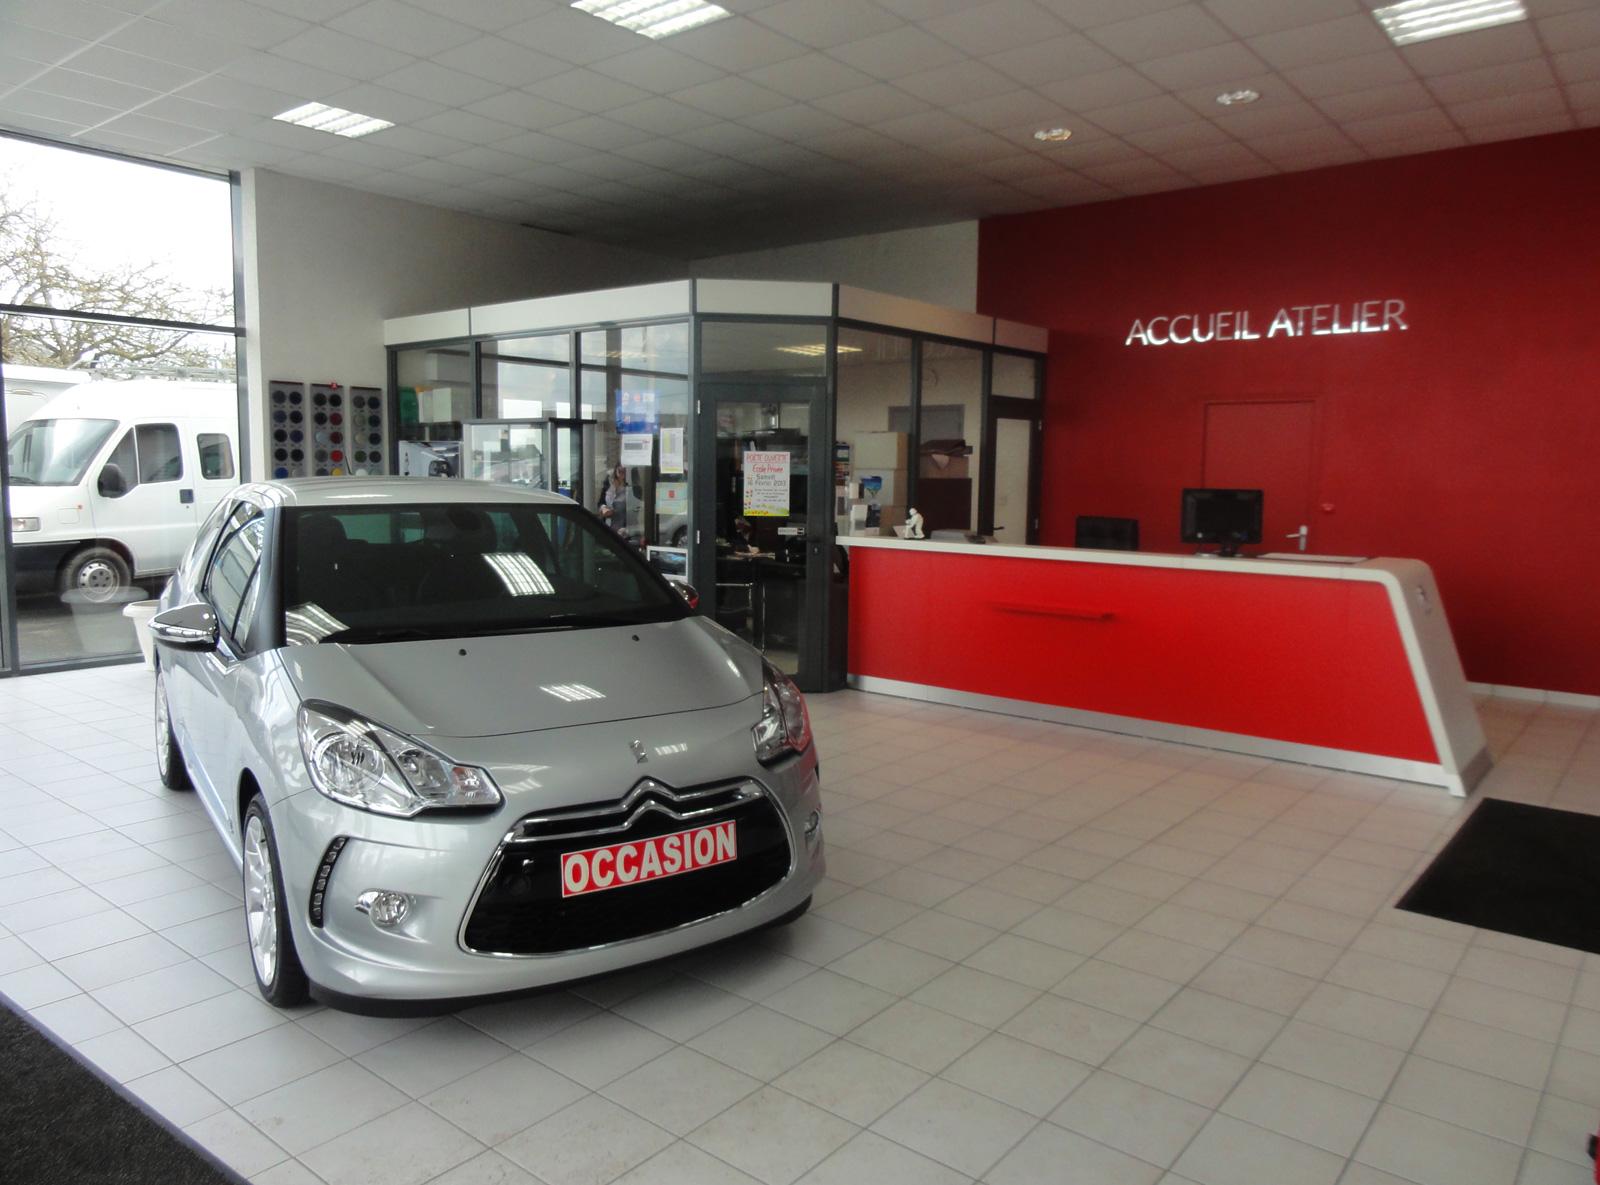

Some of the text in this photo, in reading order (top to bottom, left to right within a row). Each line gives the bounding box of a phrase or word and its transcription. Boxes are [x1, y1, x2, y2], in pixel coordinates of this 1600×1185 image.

[1125, 298, 1409, 346] ACCUEIL ATELIER
[565, 823, 736, 893] OCCASION
